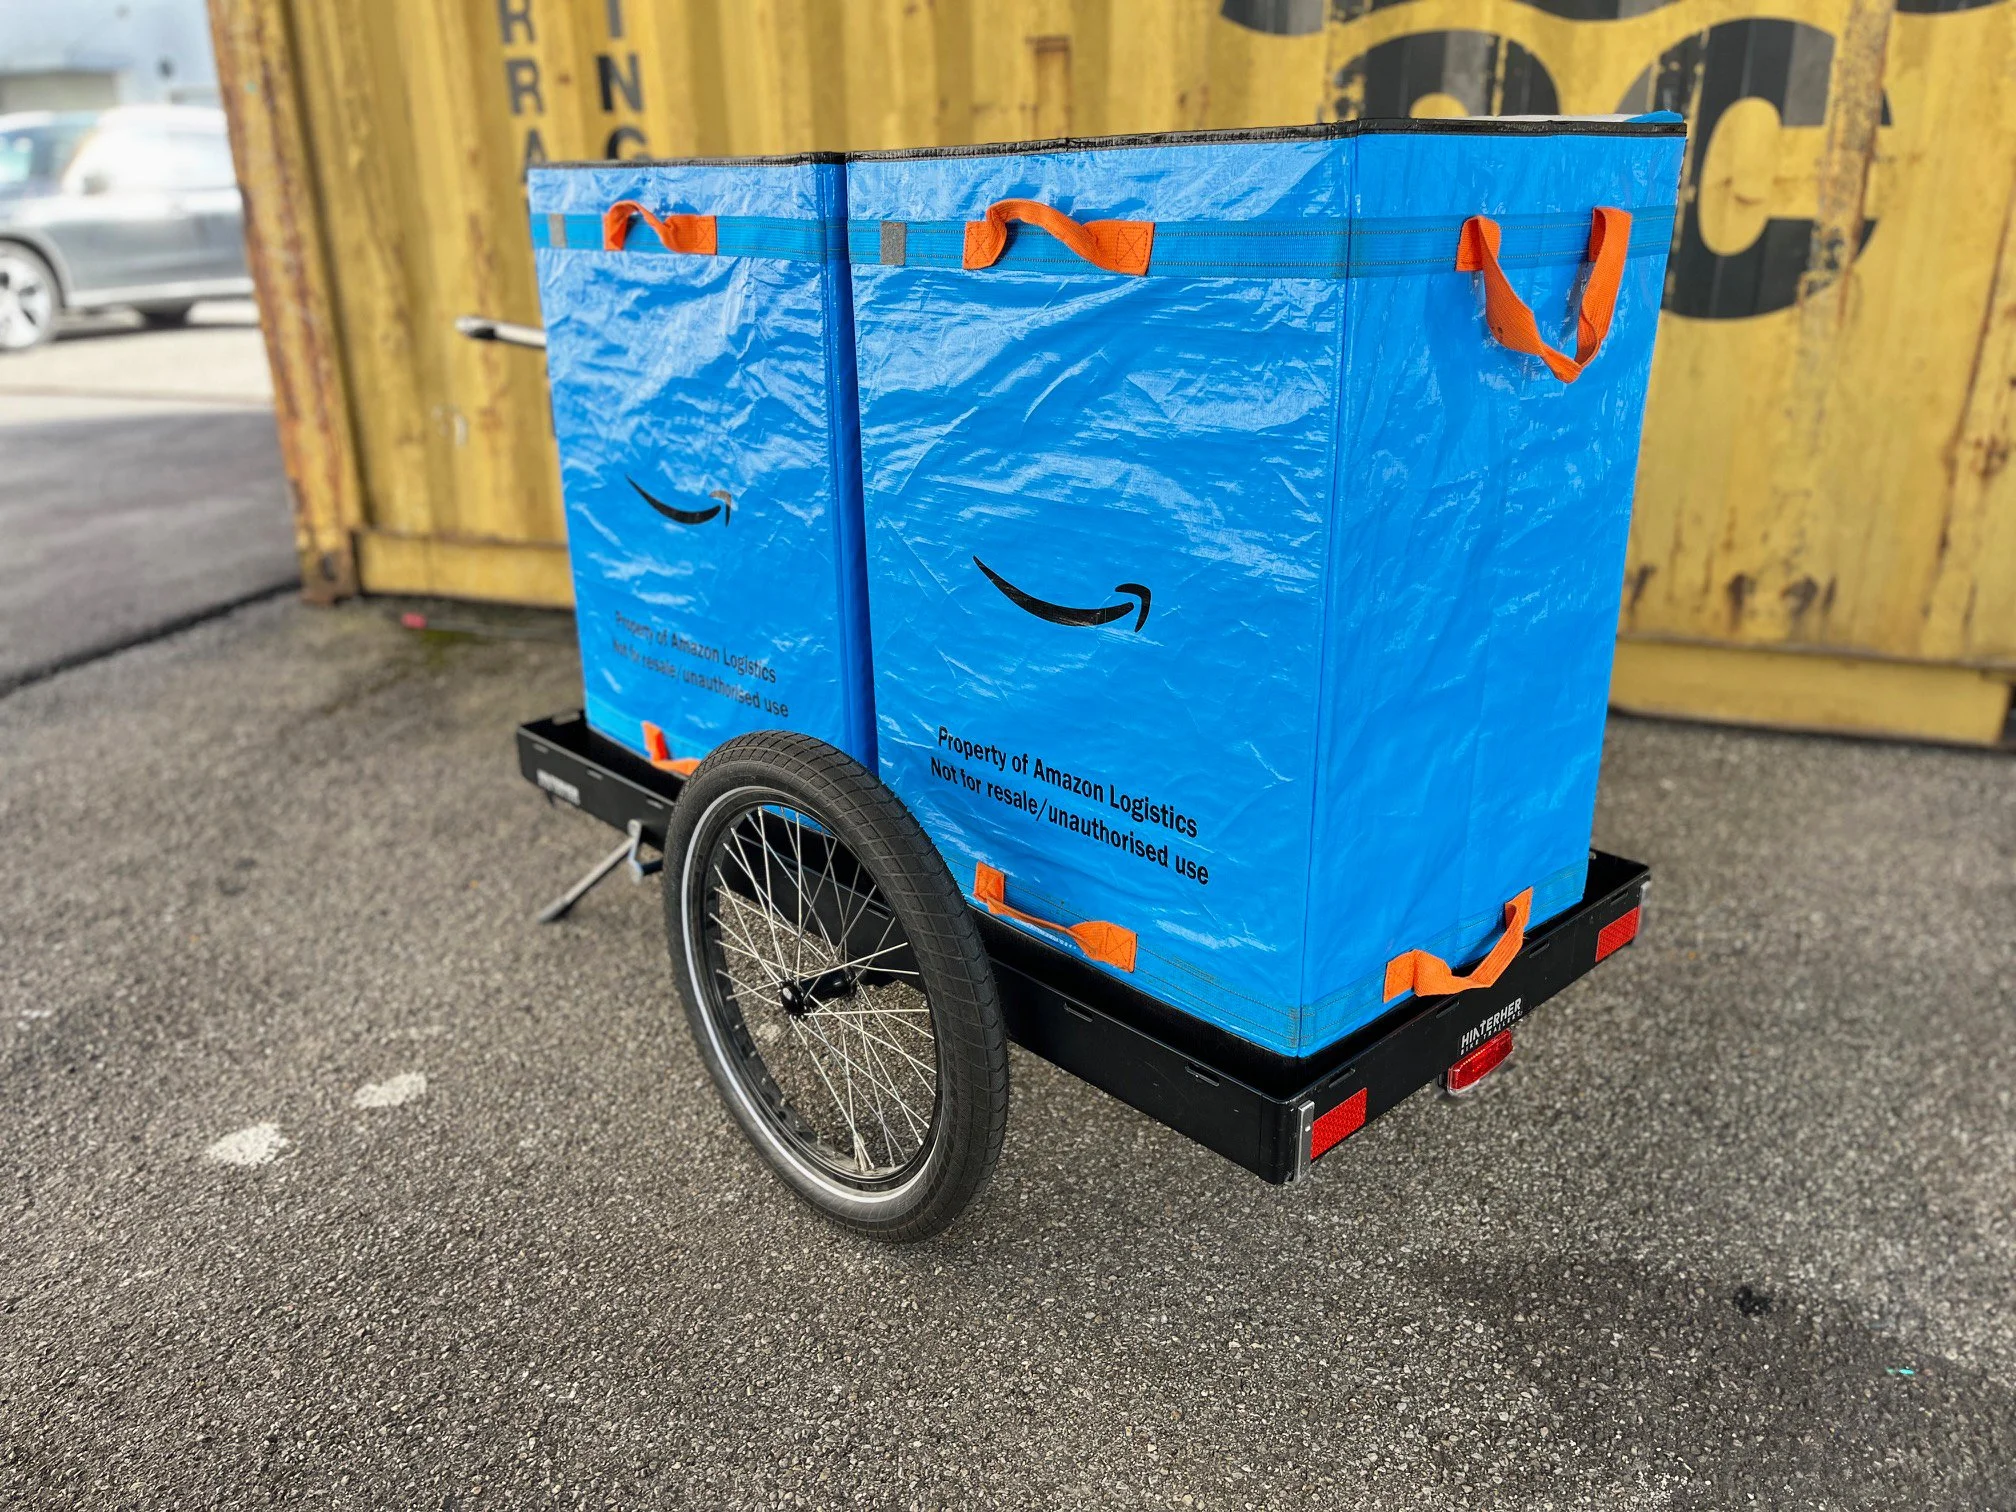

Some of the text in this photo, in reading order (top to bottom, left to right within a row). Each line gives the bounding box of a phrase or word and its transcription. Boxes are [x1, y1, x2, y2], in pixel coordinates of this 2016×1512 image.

[613, 639, 627, 657] Not
[764, 699, 789, 717] use
[615, 610, 776, 683] Property of Amazon Logistics
[938, 725, 1197, 838] Property of Amazon Logistics
[930, 756, 957, 785] Not
[961, 768, 982, 794] for
[1175, 855, 1209, 886] use
[1461, 997, 1521, 1048] HINTERHER
